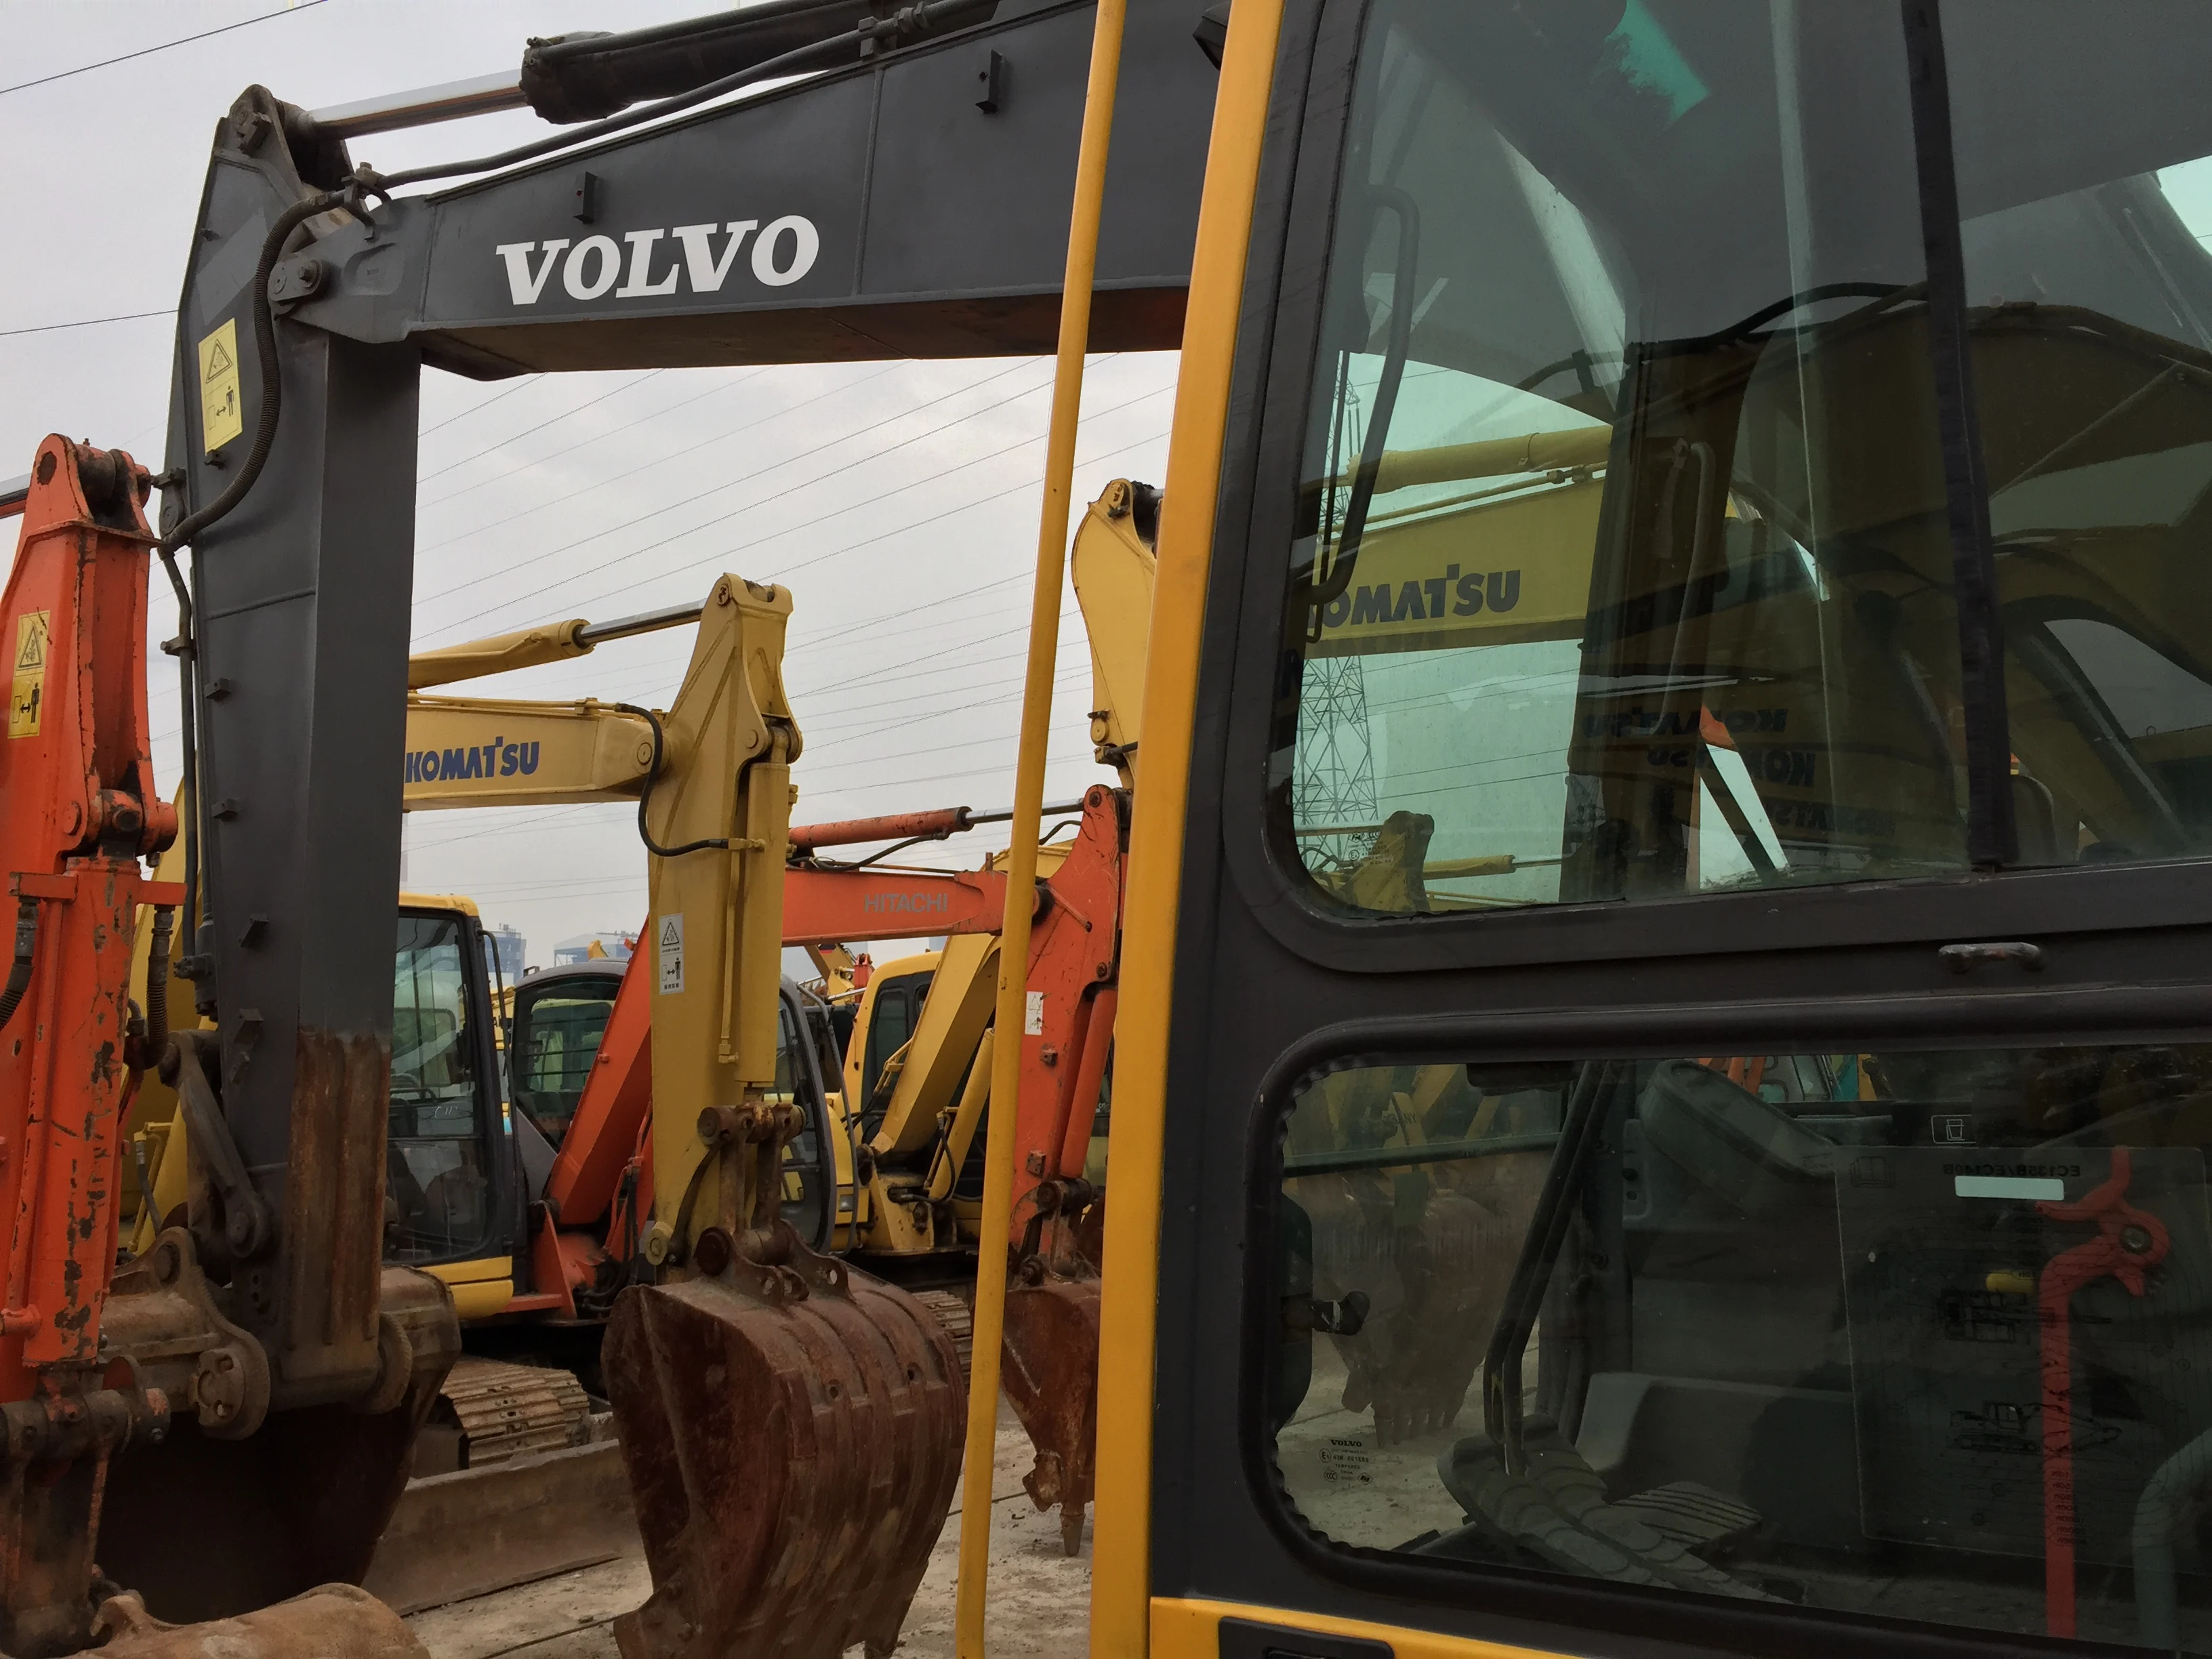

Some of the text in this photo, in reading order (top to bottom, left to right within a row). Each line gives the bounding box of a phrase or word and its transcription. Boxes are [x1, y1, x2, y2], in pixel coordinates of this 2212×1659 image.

[495, 215, 819, 305] VOLVO
[1308, 563, 1521, 629] OMATSU
[405, 736, 539, 783] KOMATSU
[863, 893, 948, 914] HITACHI
